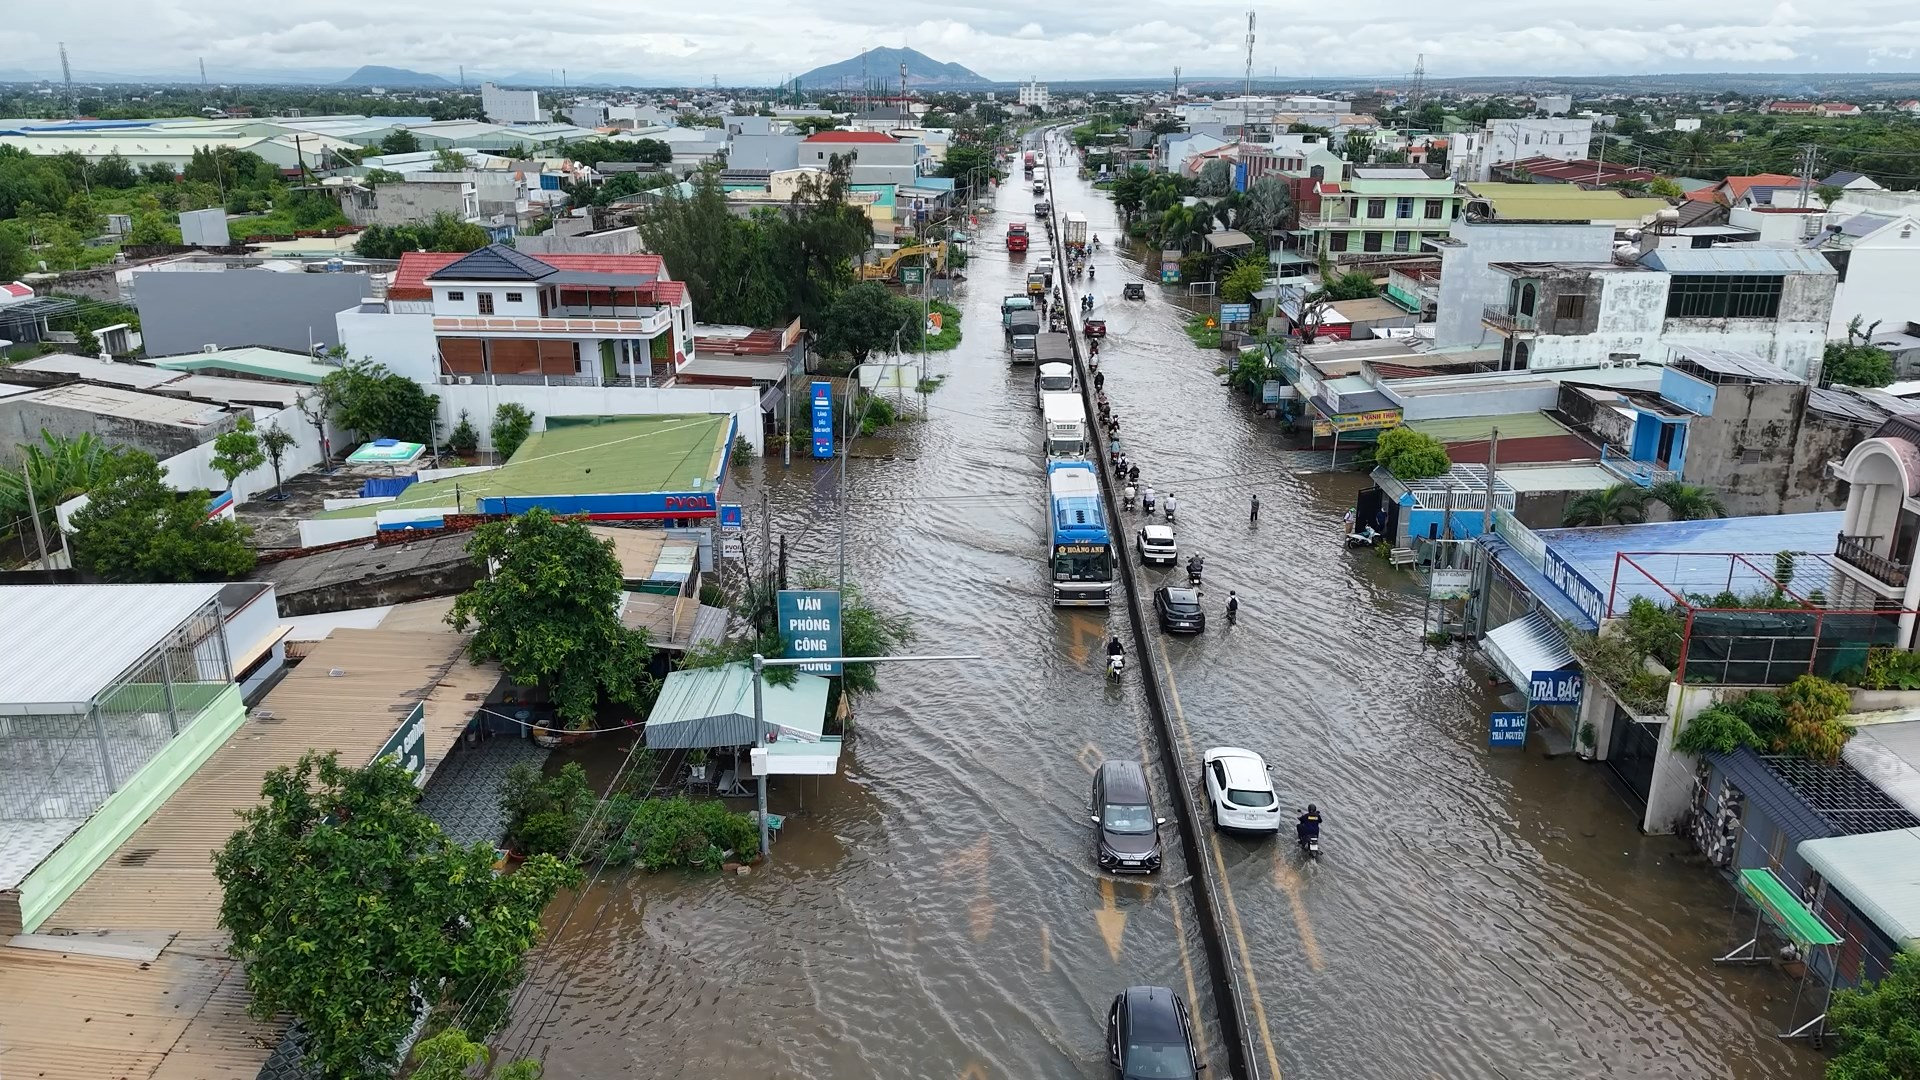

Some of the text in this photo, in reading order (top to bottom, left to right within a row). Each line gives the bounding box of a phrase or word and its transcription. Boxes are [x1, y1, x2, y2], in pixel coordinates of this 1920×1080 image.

[666, 496, 711, 509] PVOIL
[1067, 545, 1089, 553] HOÀNG
[1545, 552, 1601, 624] TRÀ BẮC THÁI NGUYÊN
[797, 595, 821, 611] VĂN
[789, 616, 830, 631] PHÒNG
[794, 636, 827, 651] CÔNG
[1532, 676, 1580, 697] TRÀ BẮC
[1495, 716, 1525, 727] TRÀ BẮC
[1492, 729, 1504, 740] THÁI
